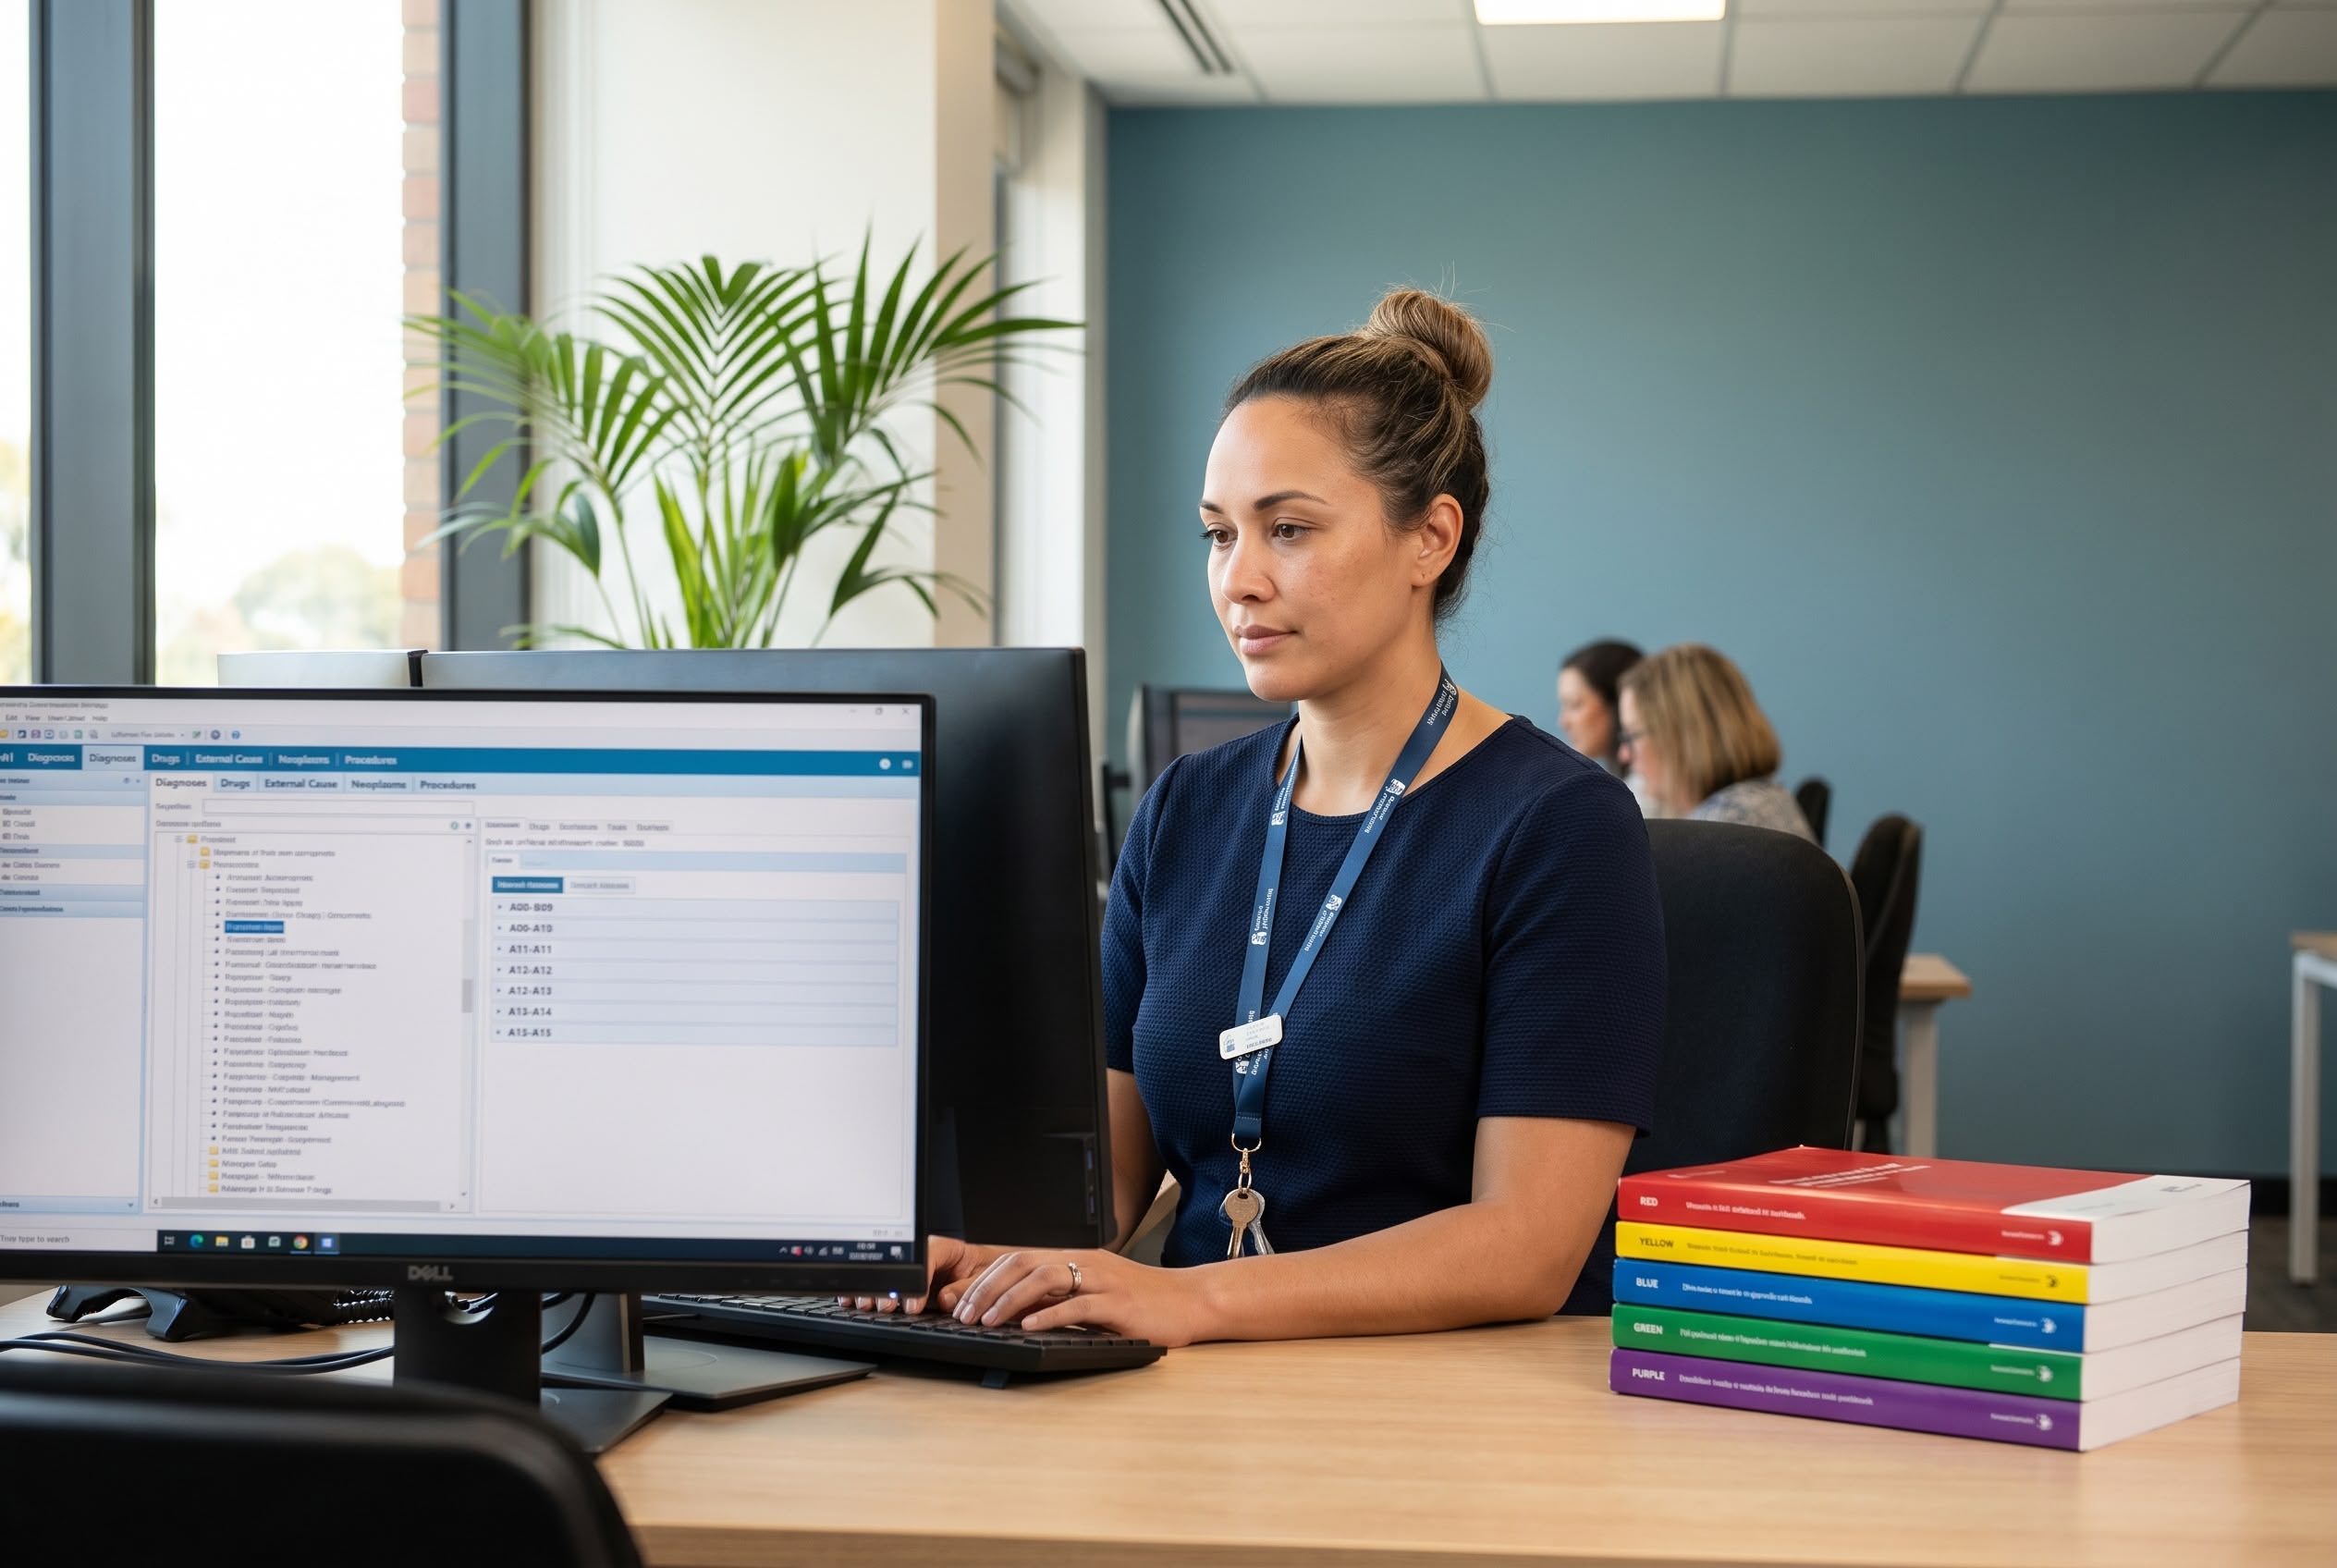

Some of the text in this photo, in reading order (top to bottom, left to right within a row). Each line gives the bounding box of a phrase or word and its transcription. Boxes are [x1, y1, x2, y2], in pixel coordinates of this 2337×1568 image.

[89, 753, 137, 765] Diagnoses
[152, 753, 180, 766] Drugs
[195, 754, 233, 764] External
[344, 755, 398, 766] Procedures
[155, 778, 207, 790] Diagnoses
[220, 779, 251, 790] Drugs
[264, 779, 306, 789] External
[309, 779, 338, 789] Cause
[420, 780, 476, 790] Procedures
[508, 965, 552, 975] A12-A12
[1639, 1195, 1658, 1207] RED
[1639, 1236, 1674, 1249] YELLOW
[407, 1265, 453, 1281] DELL
[1635, 1277, 1658, 1290] BLUE
[1633, 1322, 1663, 1335] GREEN
[1632, 1367, 1665, 1382] PURPLE
